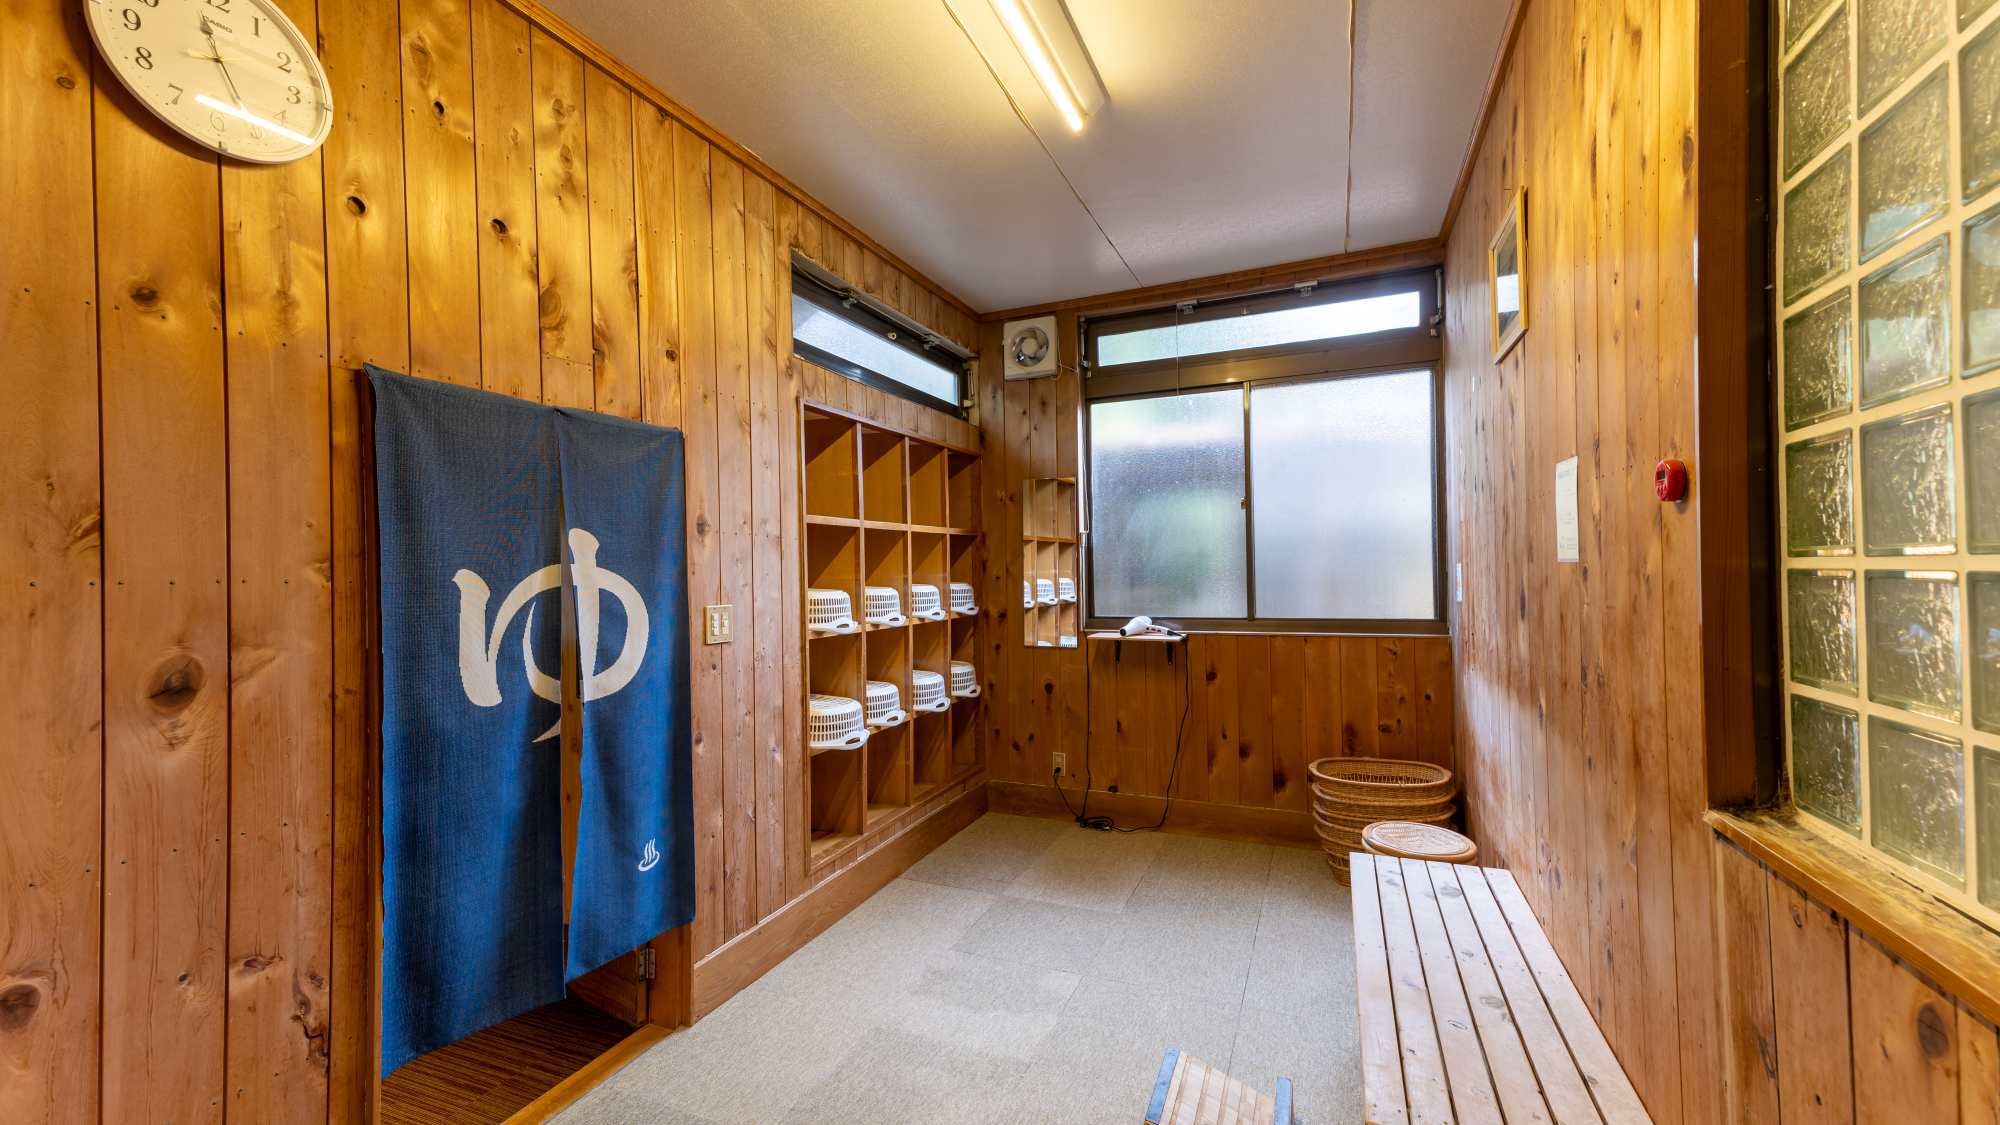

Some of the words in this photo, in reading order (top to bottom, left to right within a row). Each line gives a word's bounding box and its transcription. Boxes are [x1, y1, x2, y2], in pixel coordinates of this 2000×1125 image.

[122, 8, 141, 31] 9
[251, 15, 262, 39] 1
[135, 46, 153, 70] 8
[276, 51, 291, 74] 2
[167, 82, 184, 105] 7
[286, 85, 301, 105] 3
[209, 110, 225, 133] 6
[273, 109, 287, 126] 4
[451, 527, 650, 743] ゆ
